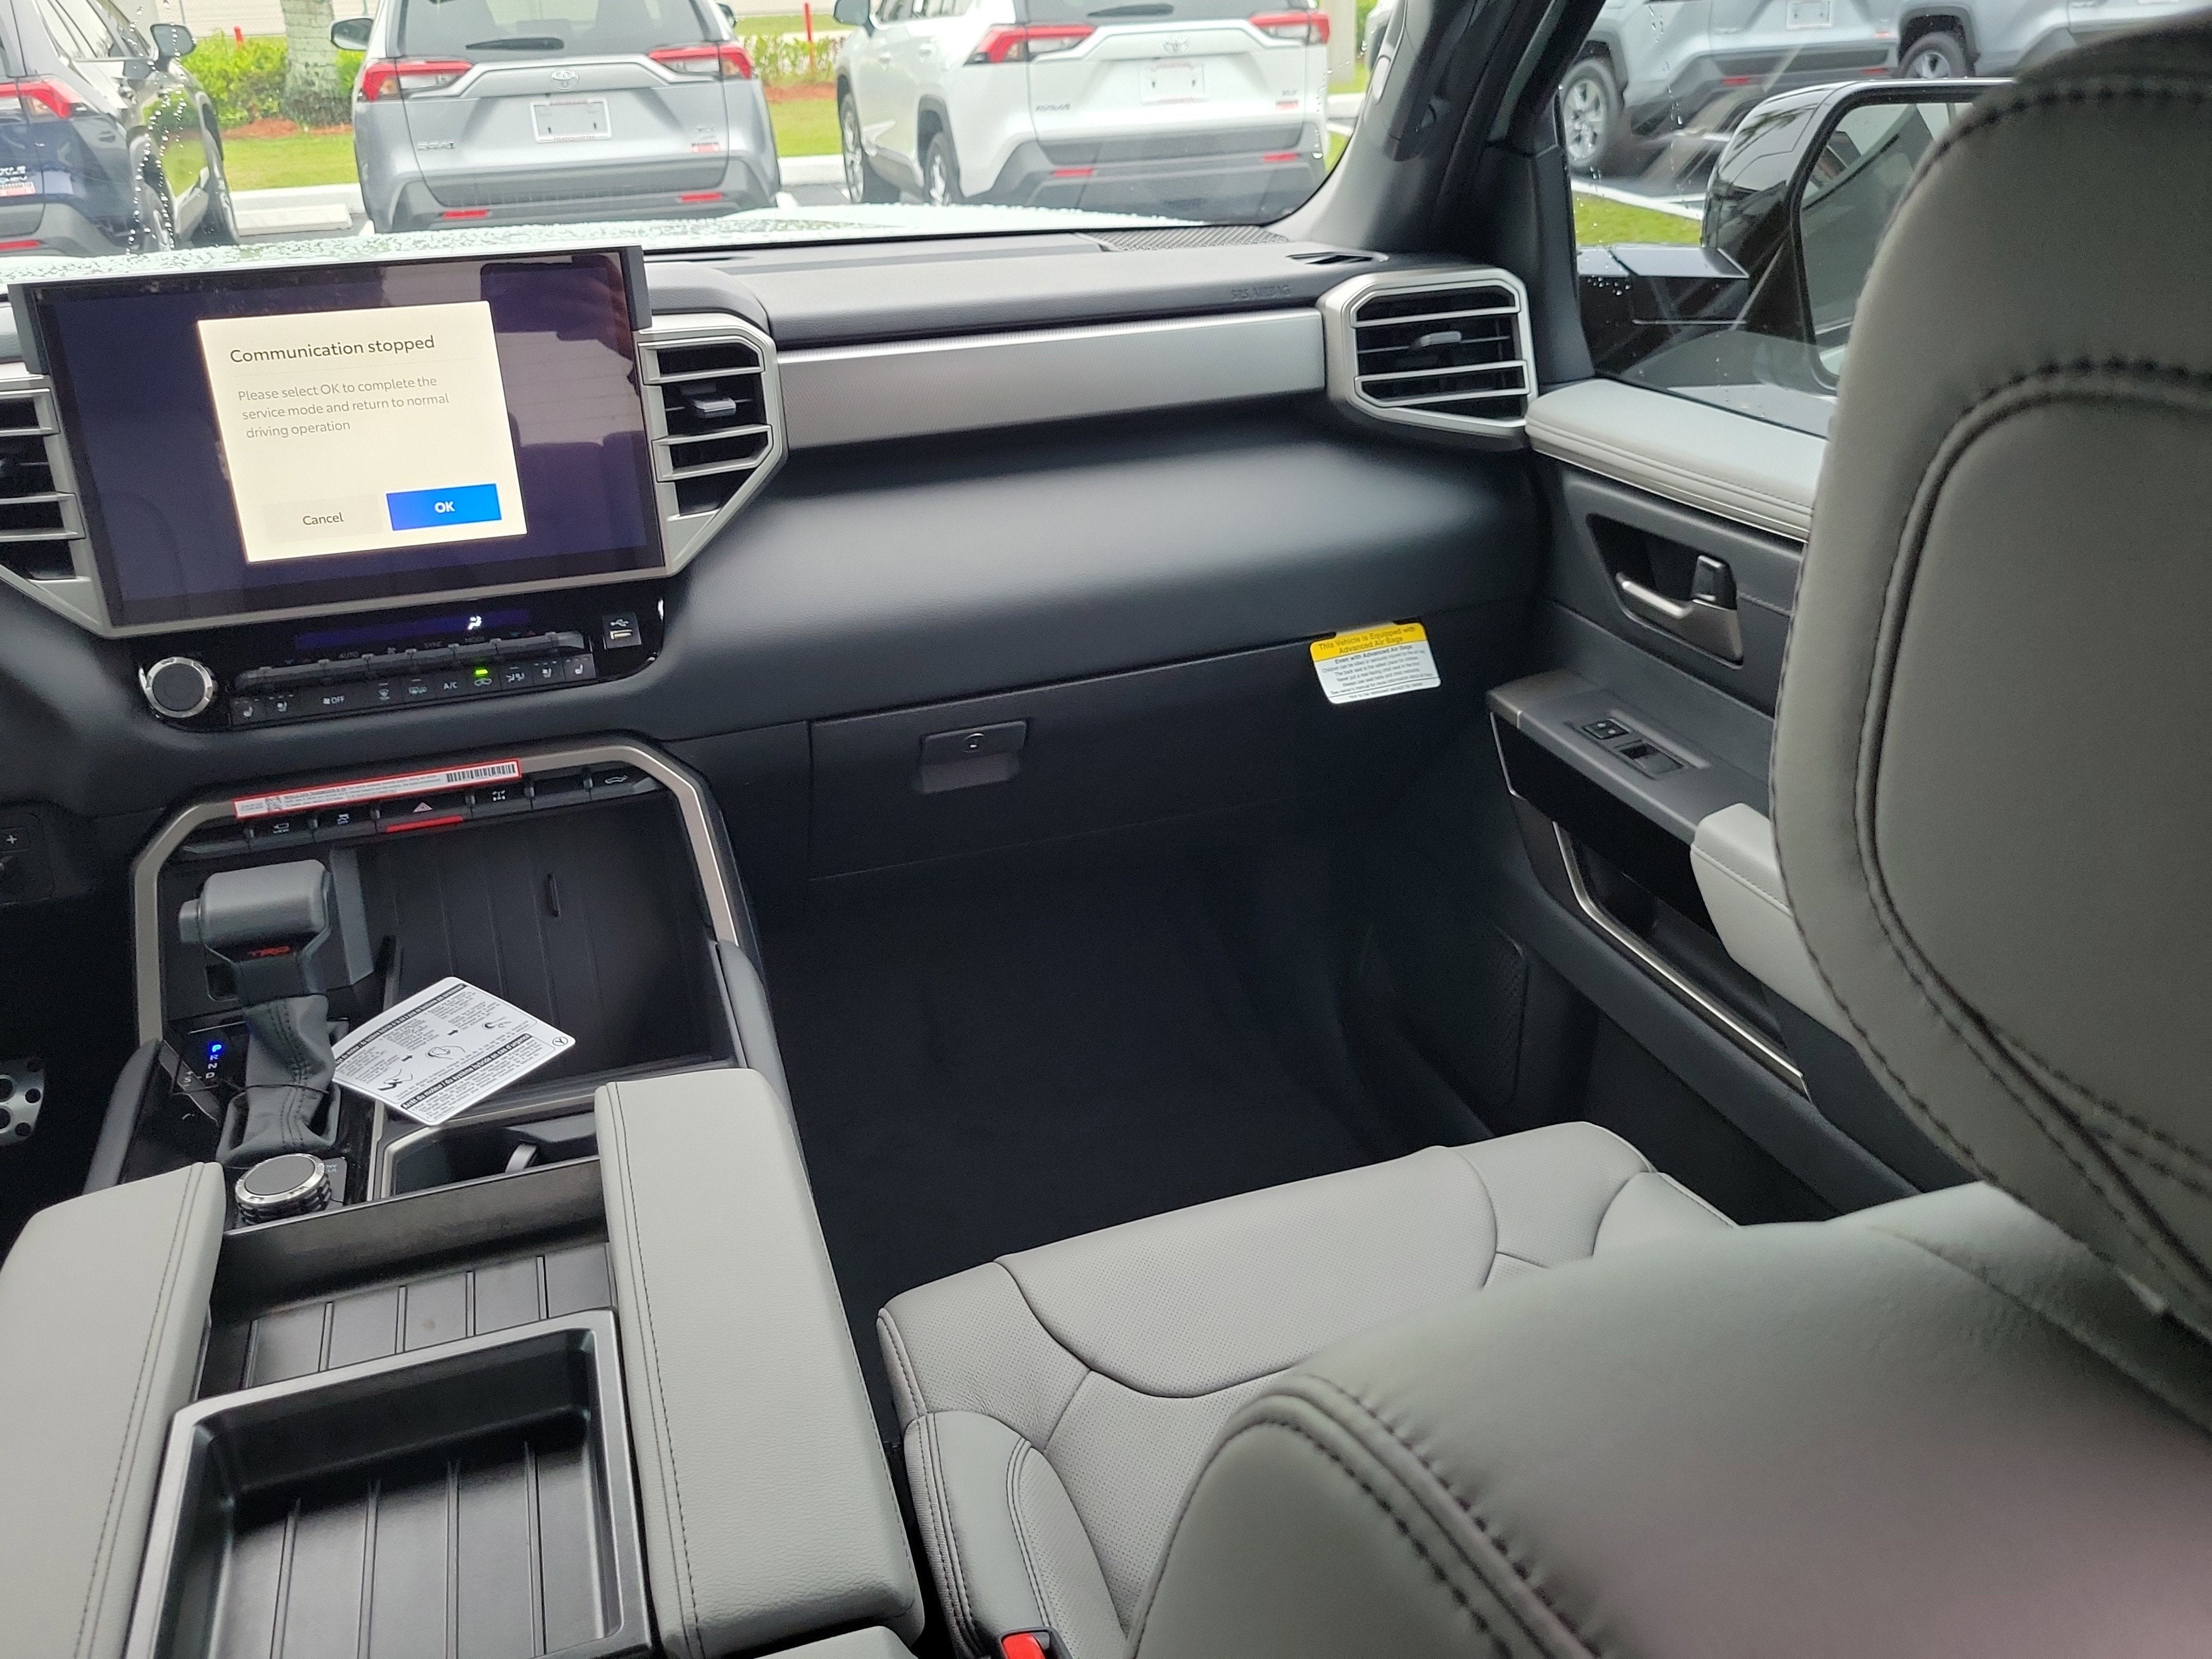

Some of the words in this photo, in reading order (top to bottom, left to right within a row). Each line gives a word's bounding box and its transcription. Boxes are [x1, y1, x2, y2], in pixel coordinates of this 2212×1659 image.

[230, 341, 364, 363] Communication
[368, 335, 435, 354] stopped
[238, 390, 279, 401] Please
[281, 386, 319, 398] select
[320, 383, 340, 394] OK
[342, 383, 355, 393] to
[358, 379, 415, 392] complete
[417, 376, 437, 387] the
[242, 407, 285, 420] service
[288, 404, 324, 416] mode
[326, 400, 349, 413] and
[352, 400, 389, 411] return
[391, 398, 404, 408] to
[407, 393, 450, 407] normal
[246, 426, 289, 438] driving
[291, 421, 351, 436] operation
[435, 501, 455, 514] OK
[302, 512, 345, 525] Cancel
[1318, 641, 1334, 650] This
[1334, 635, 1361, 646] Vehicle
[1369, 628, 1401, 640] Equipped
[1338, 641, 1373, 653] Advanced
[443, 681, 458, 690] A/C
[331, 695, 345, 704] OFF
